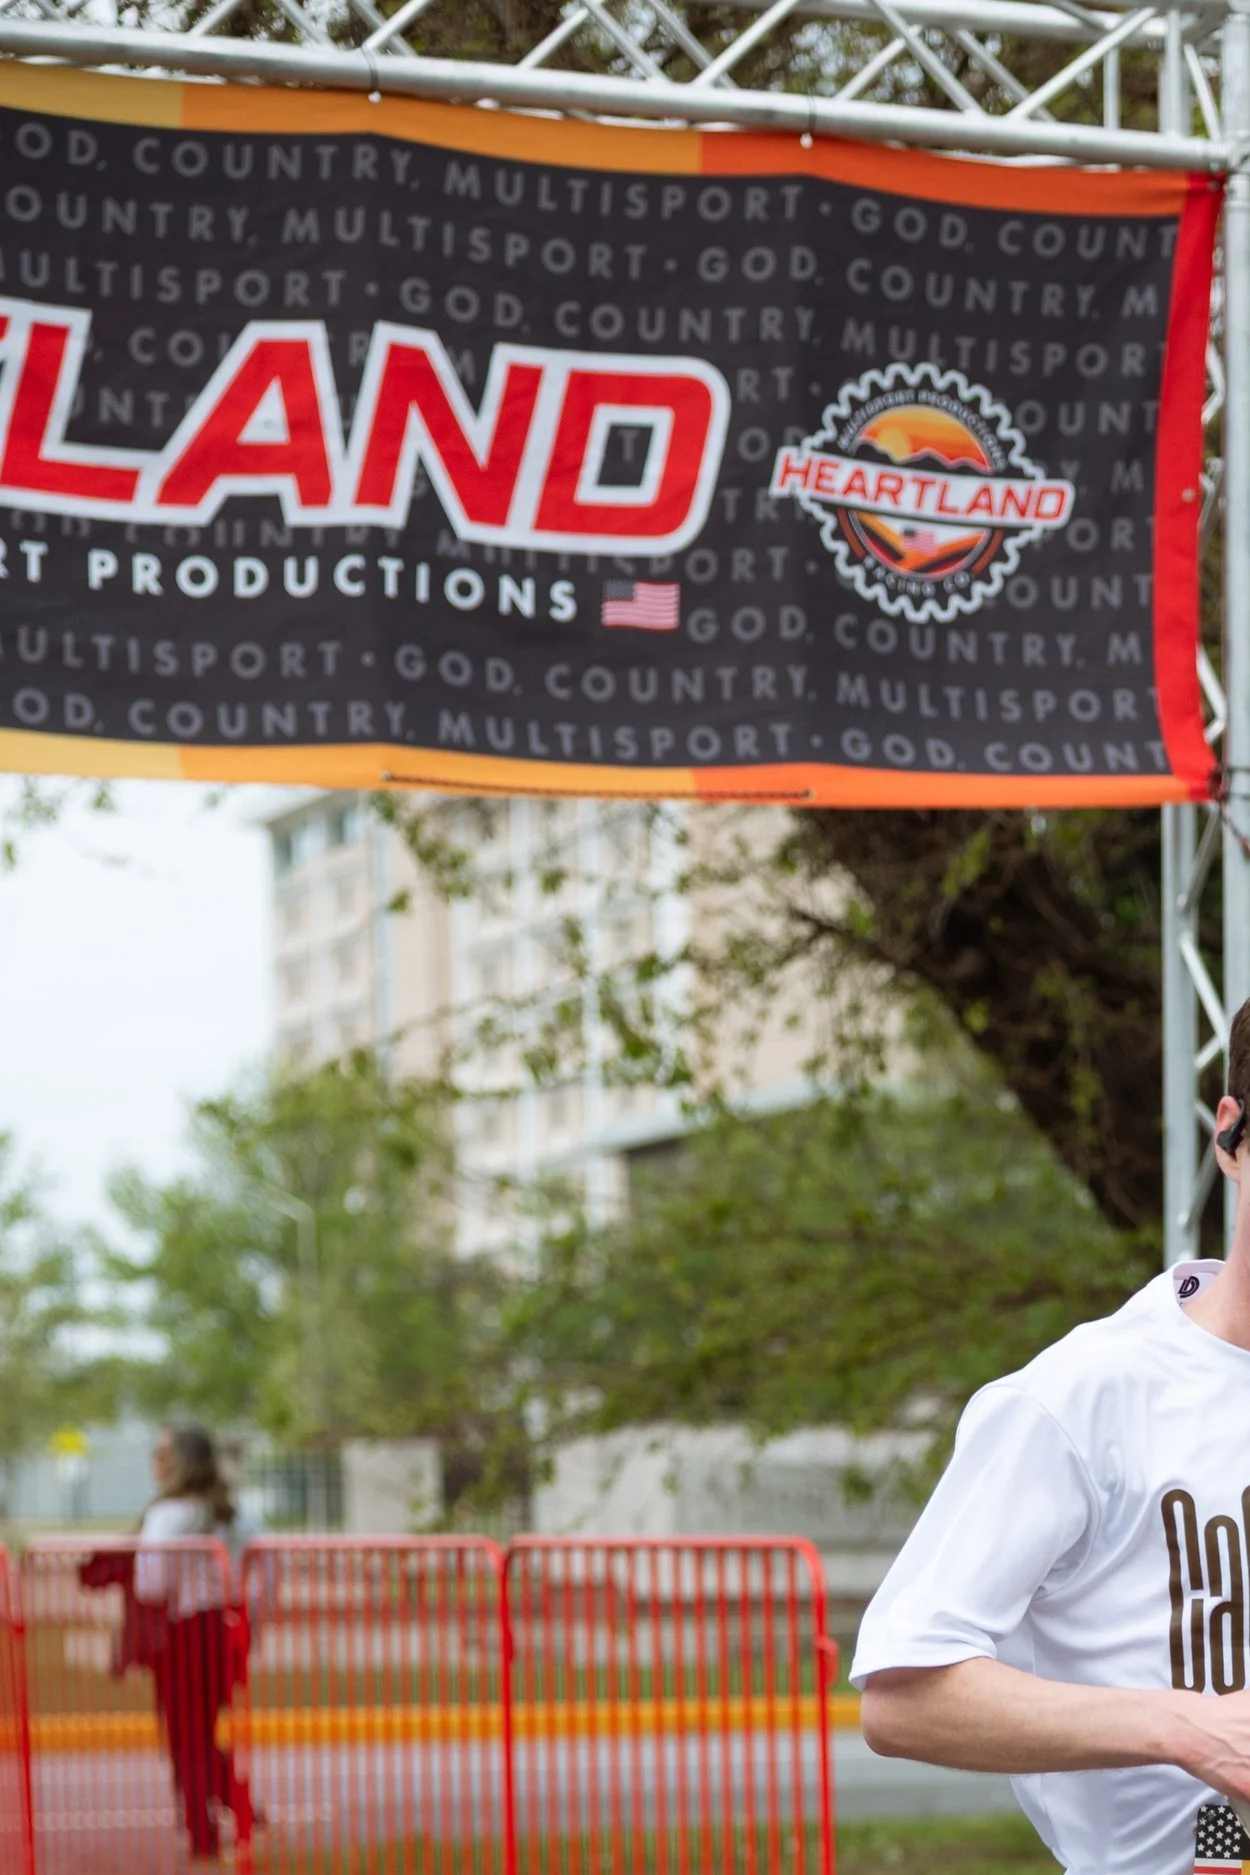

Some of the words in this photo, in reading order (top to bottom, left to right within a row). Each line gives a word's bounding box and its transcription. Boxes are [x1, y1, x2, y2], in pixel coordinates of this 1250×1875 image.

[132, 136, 421, 190] COUNTRY,
[442, 159, 804, 222] MULTISPORT
[851, 196, 975, 254] GOD,
[0, 247, 348, 307] ULTISPORT
[400, 277, 532, 336] GOD,
[554, 299, 823, 348] COUNTRY,
[280, 204, 649, 282] MULTISPORT
[696, 244, 825, 288] GOD,
[845, 257, 1102, 320] COUNTRY,
[0, 299, 731, 557] LAND
[1012, 399, 1162, 436] OUNT
[776, 453, 1069, 522] HEARTLAND
[88, 547, 578, 622] PRODUCTIONS
[1004, 571, 1155, 612] OUNT
[0, 624, 343, 680] ULTISPORT
[393, 642, 523, 698] GOD,
[544, 662, 817, 704] COUNTRY,
[686, 604, 816, 644] GOD,
[833, 612, 1086, 671] COUNTRY,
[127, 697, 417, 743] COUNTRY,
[437, 707, 793, 762] MULTISPORT
[838, 725, 966, 772] GOD,
